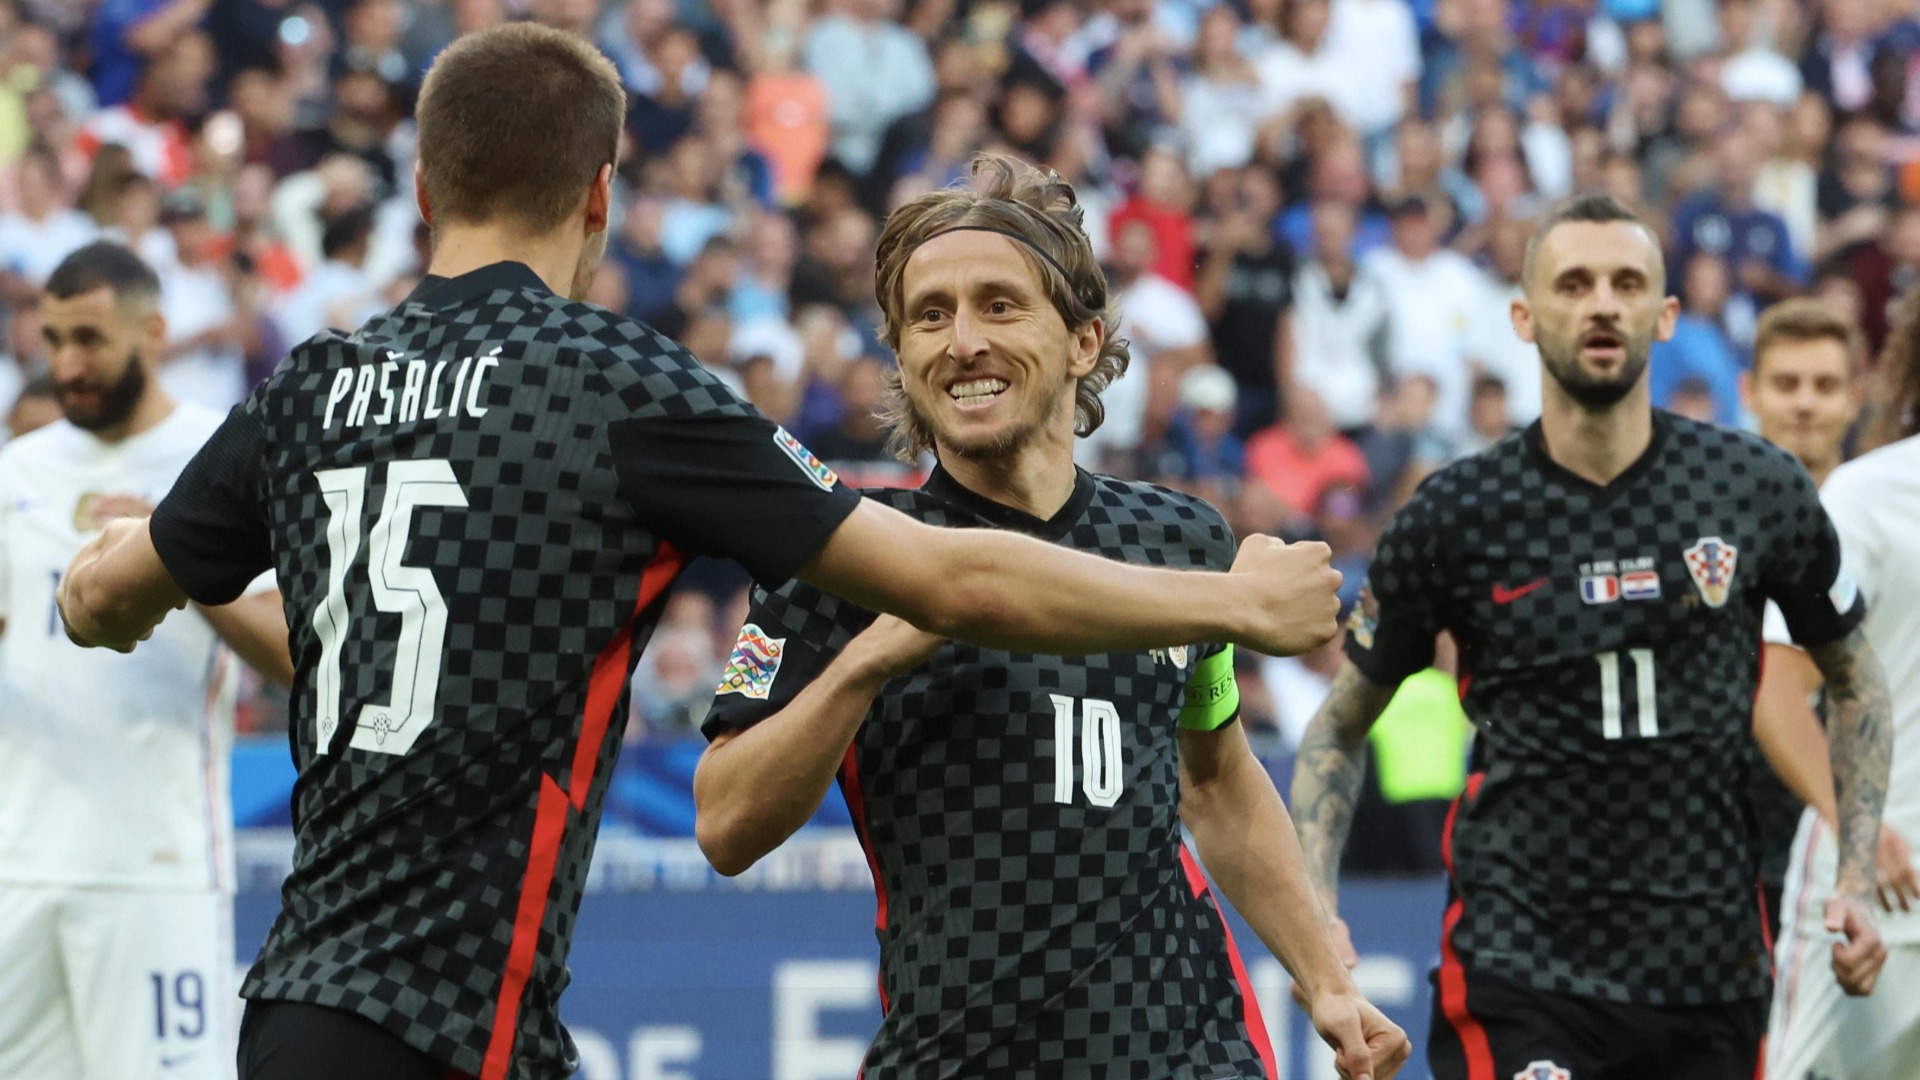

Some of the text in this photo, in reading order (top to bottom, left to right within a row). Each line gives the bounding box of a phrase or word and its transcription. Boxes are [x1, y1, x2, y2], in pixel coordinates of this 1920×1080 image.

[323, 346, 502, 429] PAŠALIĆ
[313, 459, 469, 756] 15
[1594, 648, 1659, 739] 11
[1048, 692, 1123, 808] 10
[150, 969, 205, 1039] 19
